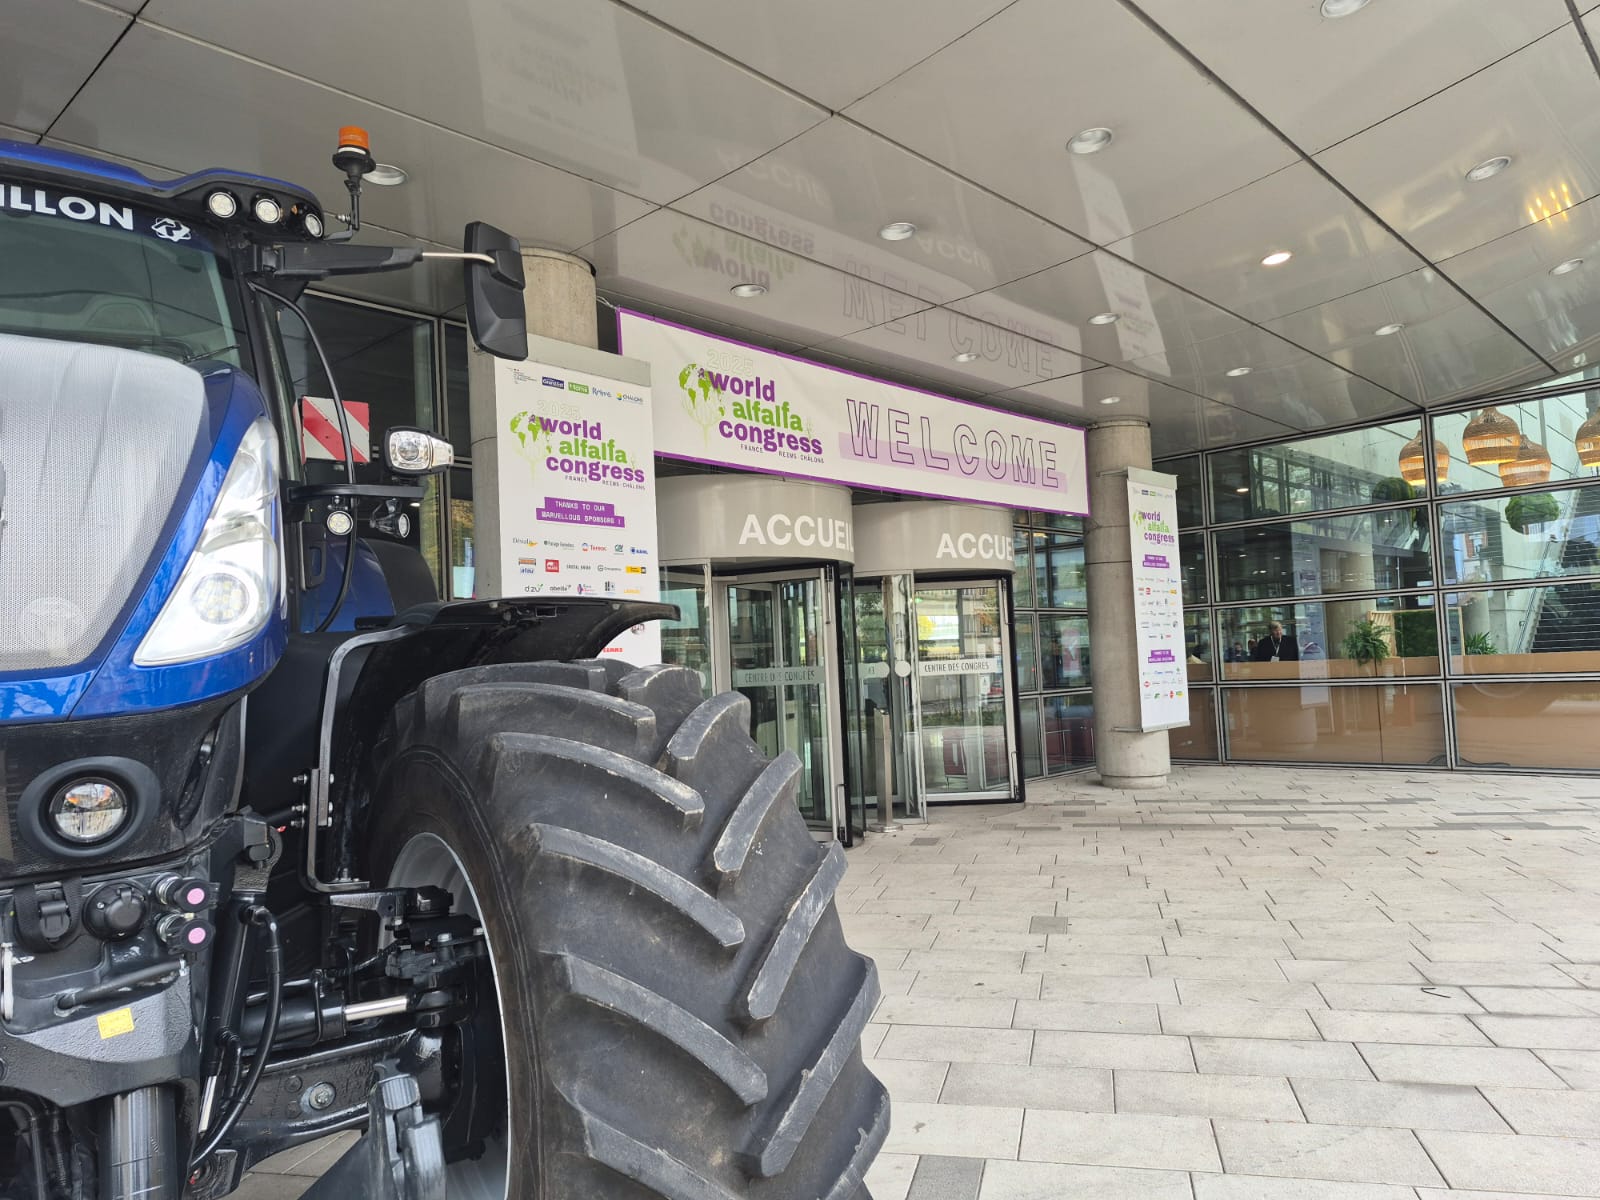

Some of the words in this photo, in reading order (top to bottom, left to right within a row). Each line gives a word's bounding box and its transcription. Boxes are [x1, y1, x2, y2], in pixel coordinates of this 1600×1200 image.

[708, 370, 775, 402] world
[732, 399, 803, 432] alfalfa
[539, 416, 602, 440] world
[718, 420, 823, 455] congress
[559, 438, 628, 464] alfalfa
[741, 443, 763, 453] FRANCE
[846, 398, 1059, 488] WELCOME
[546, 457, 645, 482] congress
[541, 511, 581, 521] MARVELLOUS
[555, 501, 578, 509] THANKS
[582, 503, 591, 511] TO
[1141, 511, 1161, 521] world
[1144, 532, 1175, 544] congress
